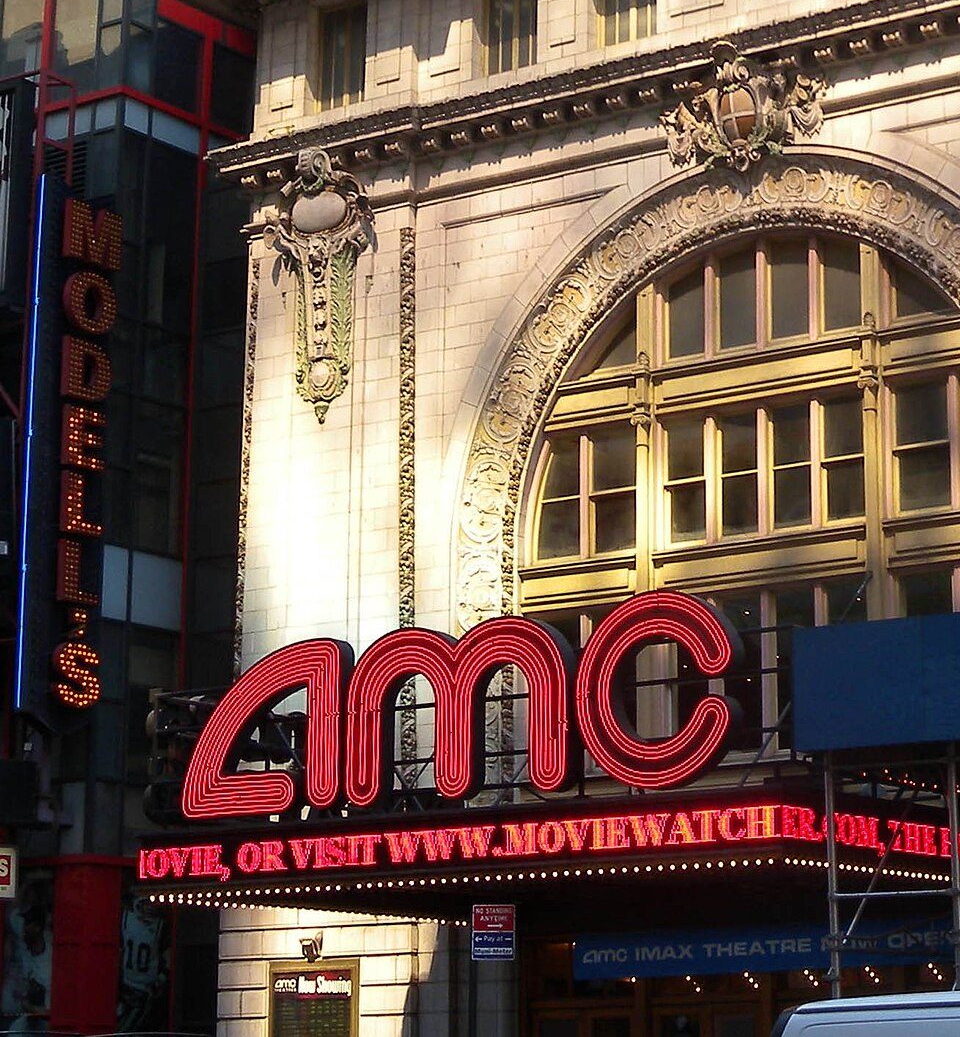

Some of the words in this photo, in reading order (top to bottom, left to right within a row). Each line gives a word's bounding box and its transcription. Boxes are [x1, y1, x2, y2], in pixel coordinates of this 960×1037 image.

[53, 197, 123, 710] MODELL'S
[140, 841, 230, 881] OVIE,
[237, 841, 289, 873] OR
[289, 835, 381, 870] VISIT
[635, 944, 694, 962] IMAX
[703, 938, 812, 958] THEATRE
